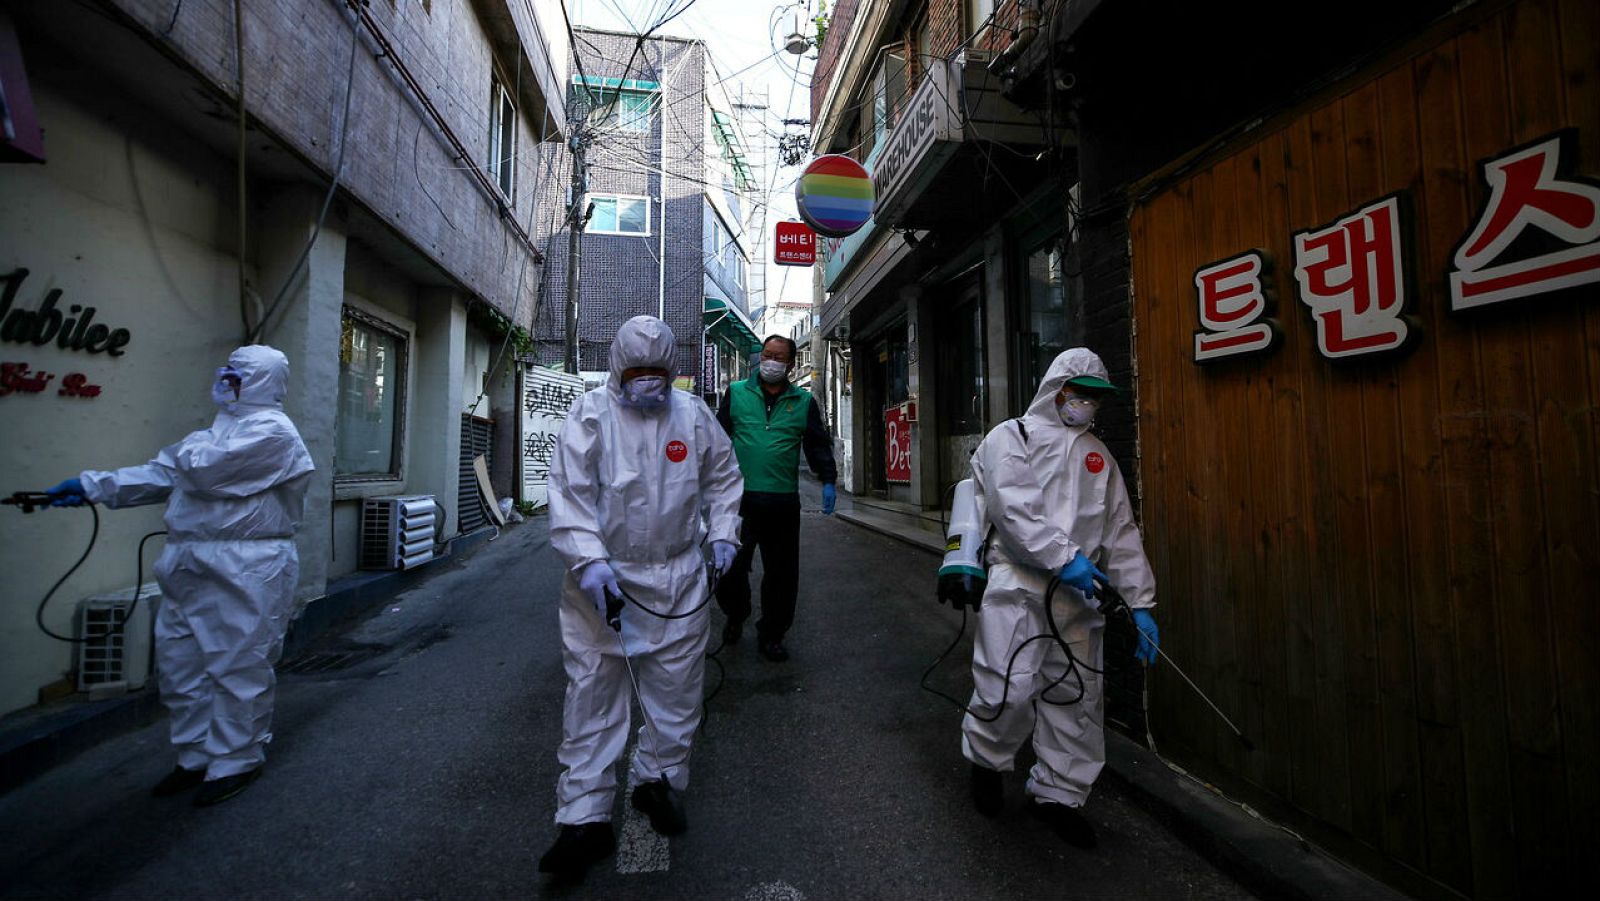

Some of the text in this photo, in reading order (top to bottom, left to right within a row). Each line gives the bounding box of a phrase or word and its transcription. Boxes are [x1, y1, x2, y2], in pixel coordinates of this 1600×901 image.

[874, 87, 934, 201] WAREHOUSE
[779, 233, 812, 245] 베티
[1195, 137, 1600, 361] 트랜스
